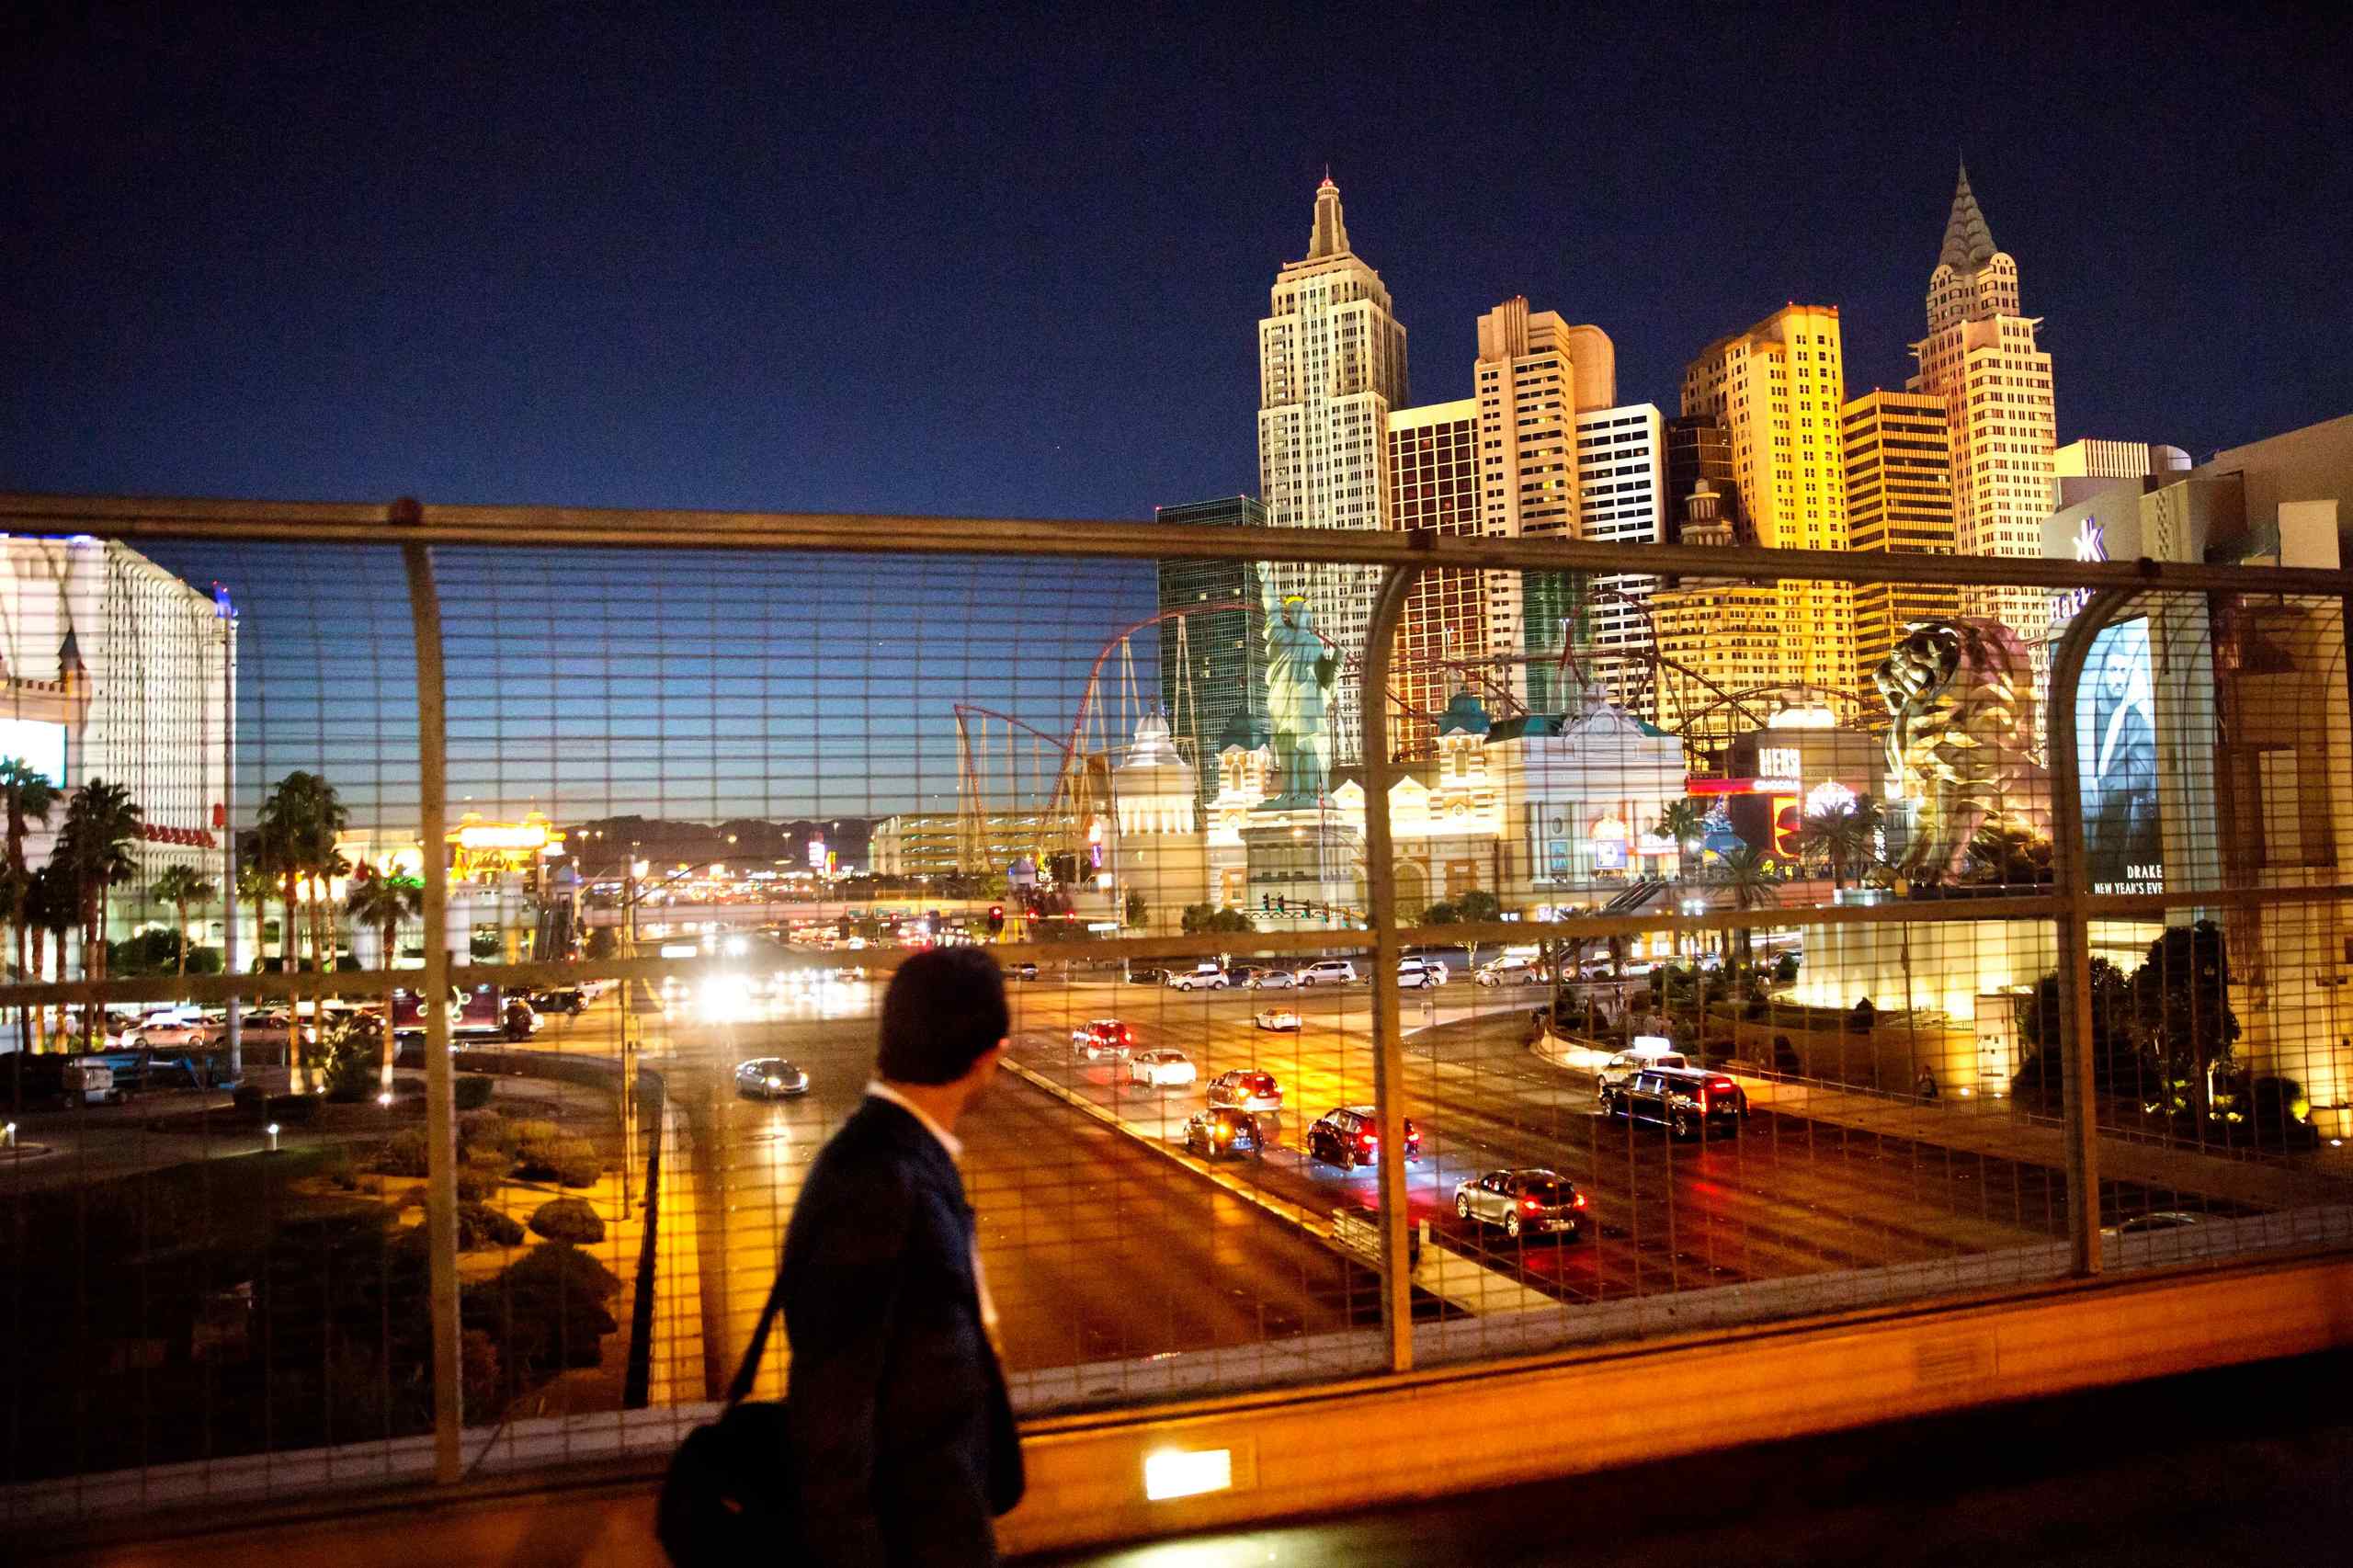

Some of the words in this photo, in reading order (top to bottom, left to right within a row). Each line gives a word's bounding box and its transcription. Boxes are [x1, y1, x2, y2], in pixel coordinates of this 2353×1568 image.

[2127, 864, 2163, 879] DRAKE
[2095, 882, 2111, 895] NEW
[2115, 882, 2144, 895] YEAR'S
